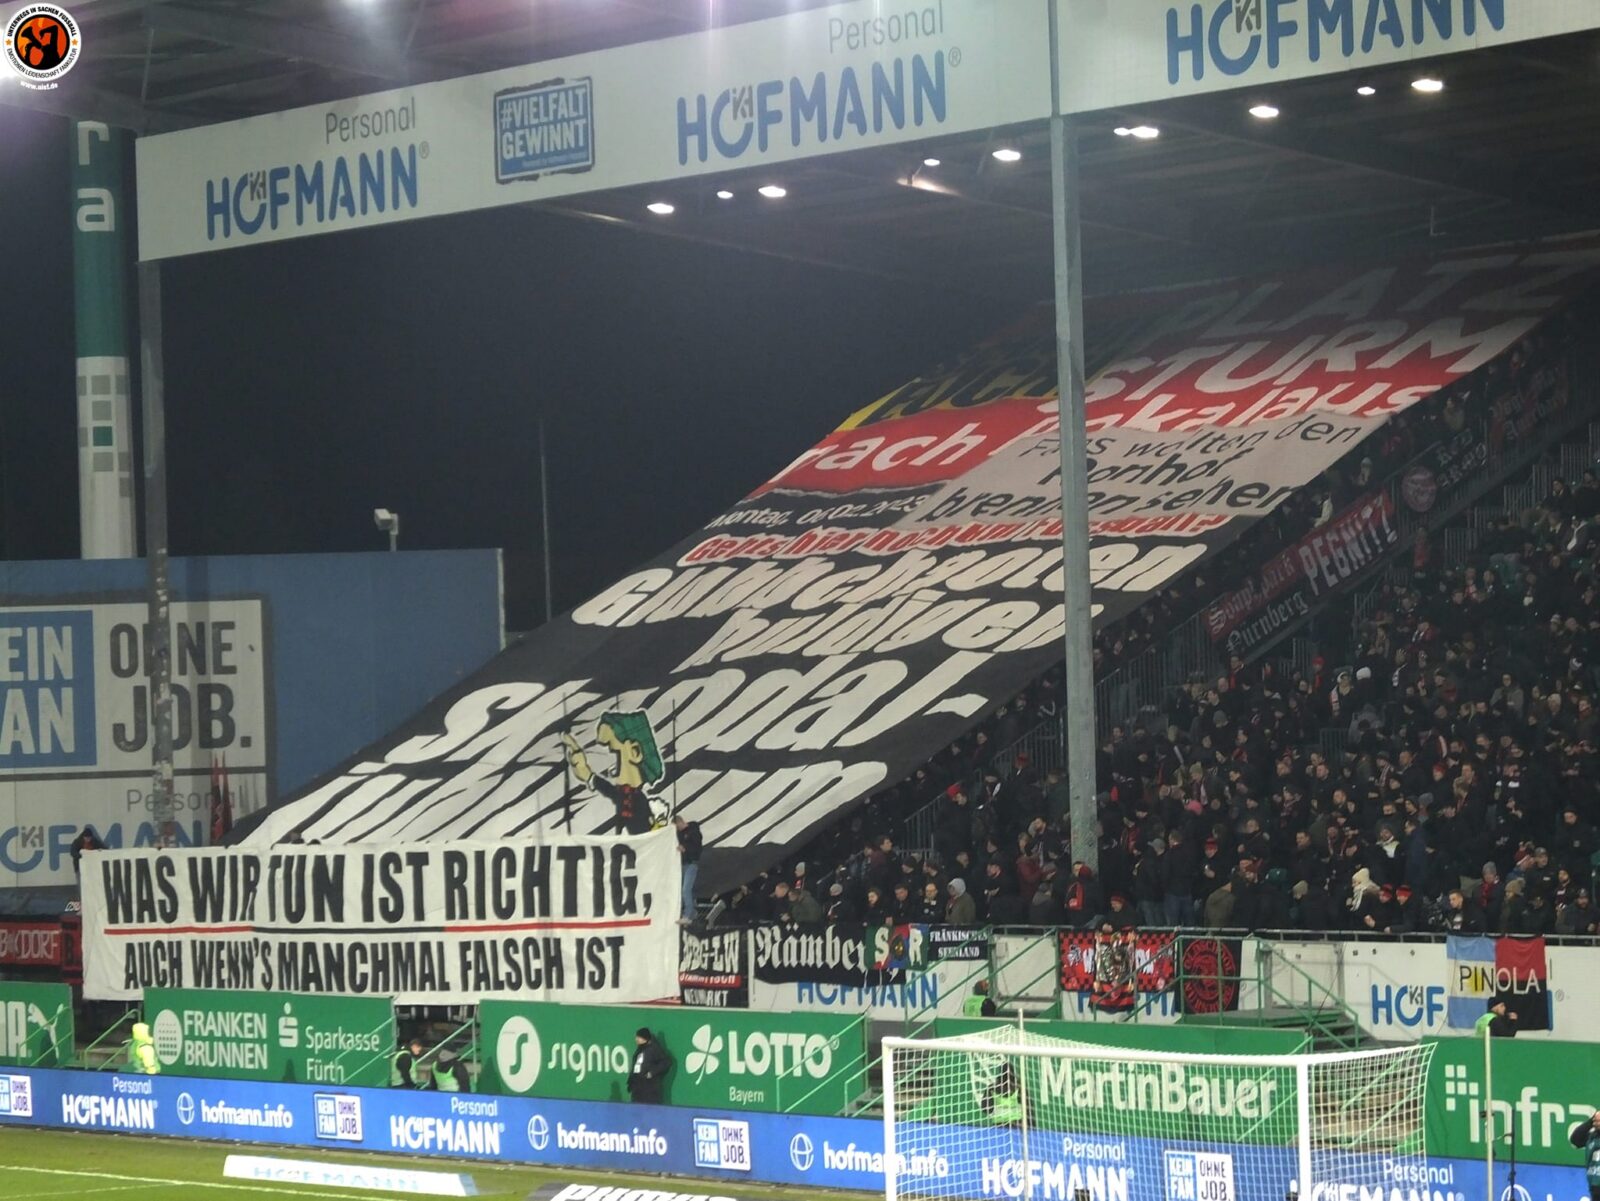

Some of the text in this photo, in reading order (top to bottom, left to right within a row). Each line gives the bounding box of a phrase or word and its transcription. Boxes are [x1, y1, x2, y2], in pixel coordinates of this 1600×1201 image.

[829, 1, 944, 53] Personal
[1167, 0, 1505, 85] HOFMANN
[326, 97, 417, 144] Personal
[501, 87, 586, 130] #VIELFALT
[676, 49, 948, 165] HOFMANN
[502, 118, 586, 160] GEWINNT
[206, 143, 418, 241] HOFMANN
[1036, 316, 1543, 413] STURM
[1275, 410, 1362, 445] den
[102, 843, 652, 924] WAS WIR TUN IST RICHTIG,
[124, 939, 182, 990] AUCH
[191, 937, 273, 991] WENN'S
[278, 941, 450, 994] MANCHMAL
[459, 937, 564, 992] FALSCH
[576, 936, 625, 990] IST
[1459, 964, 1540, 995] PINOLA
[183, 1010, 267, 1040] FRANKEN
[305, 1025, 380, 1053] Sparkasse
[183, 1039, 269, 1070] BRUNNEN
[306, 1057, 345, 1084] Fürth
[728, 1030, 833, 1079] LOTTO
[112, 1077, 153, 1093] Personal
[729, 1086, 765, 1105] Bayern
[1039, 1055, 1278, 1120] MartinBauer
[62, 1094, 155, 1130] HOFMANN
[201, 1099, 294, 1129] hofmann.info
[451, 1096, 498, 1117] Personal
[390, 1115, 501, 1155] HOFMANN
[557, 1121, 668, 1156] hofmann.info
[722, 1127, 744, 1144] OHNE
[1064, 1136, 1126, 1160] Personal
[723, 1143, 749, 1164] JOB.
[1200, 1160, 1227, 1178] OHNE
[1383, 1159, 1454, 1185] Personal
